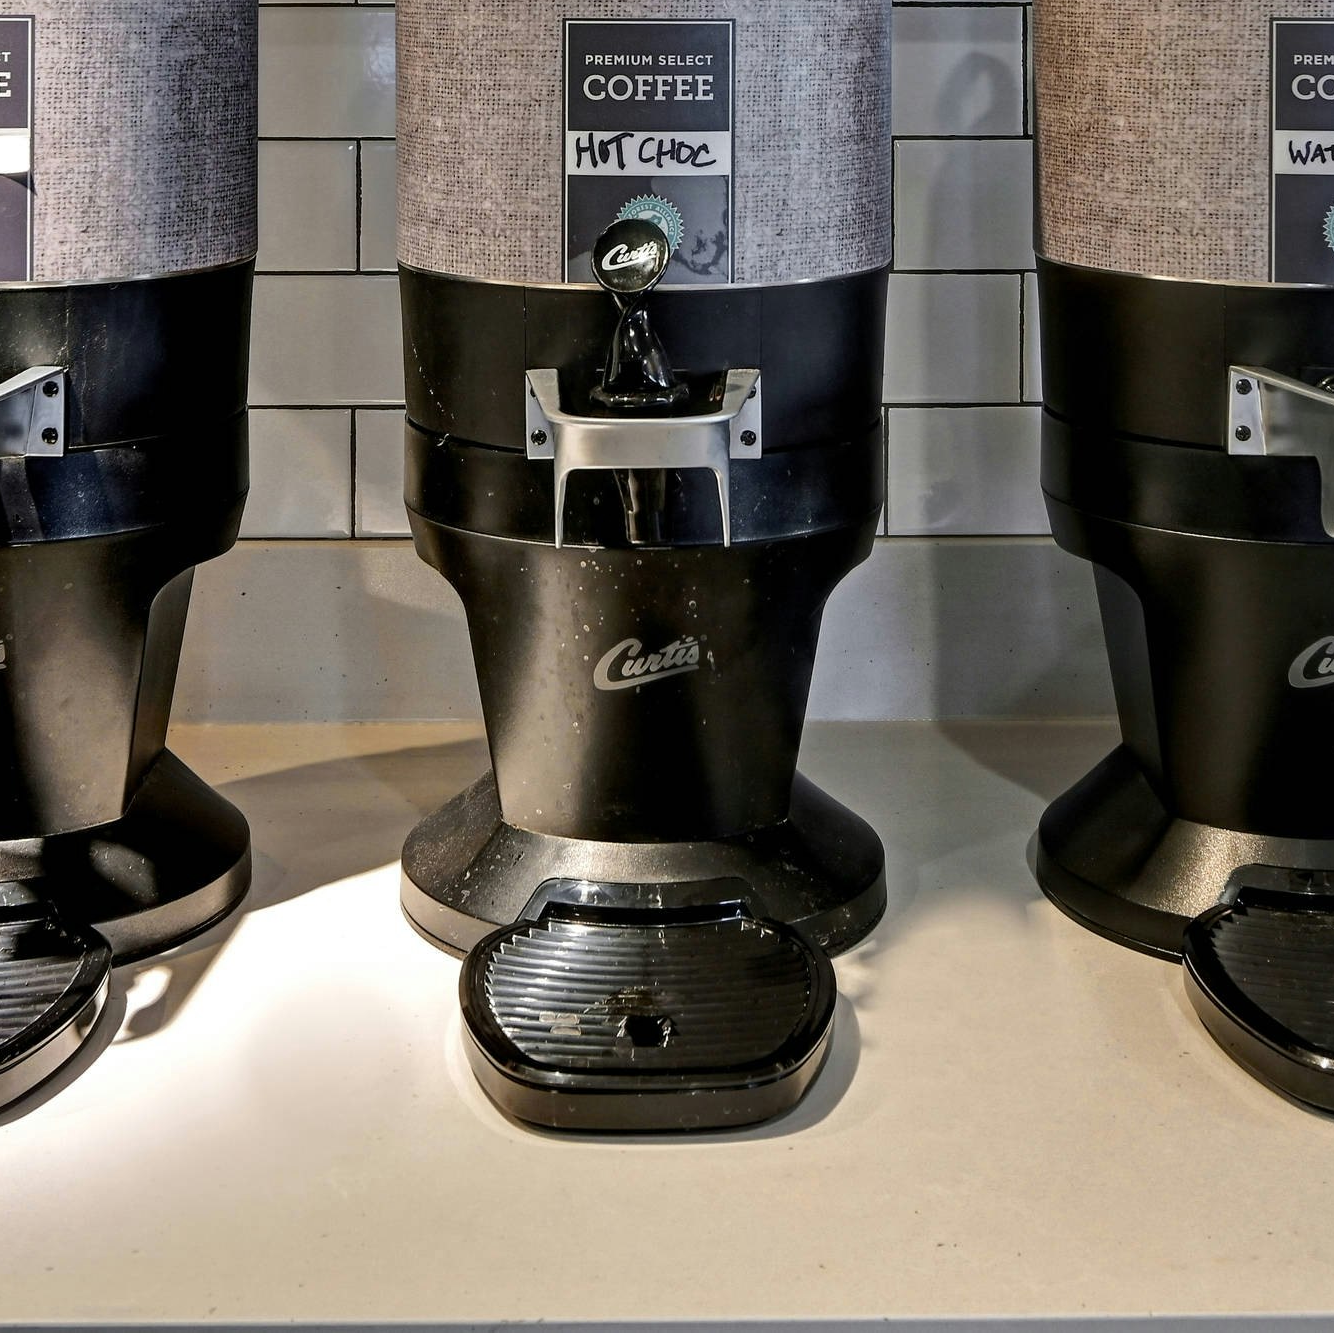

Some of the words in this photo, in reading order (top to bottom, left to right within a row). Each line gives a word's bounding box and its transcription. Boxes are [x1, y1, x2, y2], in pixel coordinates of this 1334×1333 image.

[585, 54, 653, 66] PREMIUM
[658, 54, 714, 66] SELECT
[583, 74, 714, 101] COFFEE
[575, 132, 634, 170] HOT
[638, 137, 717, 168] CHOC
[601, 240, 658, 271] Curtis
[593, 636, 700, 691] Curtis
